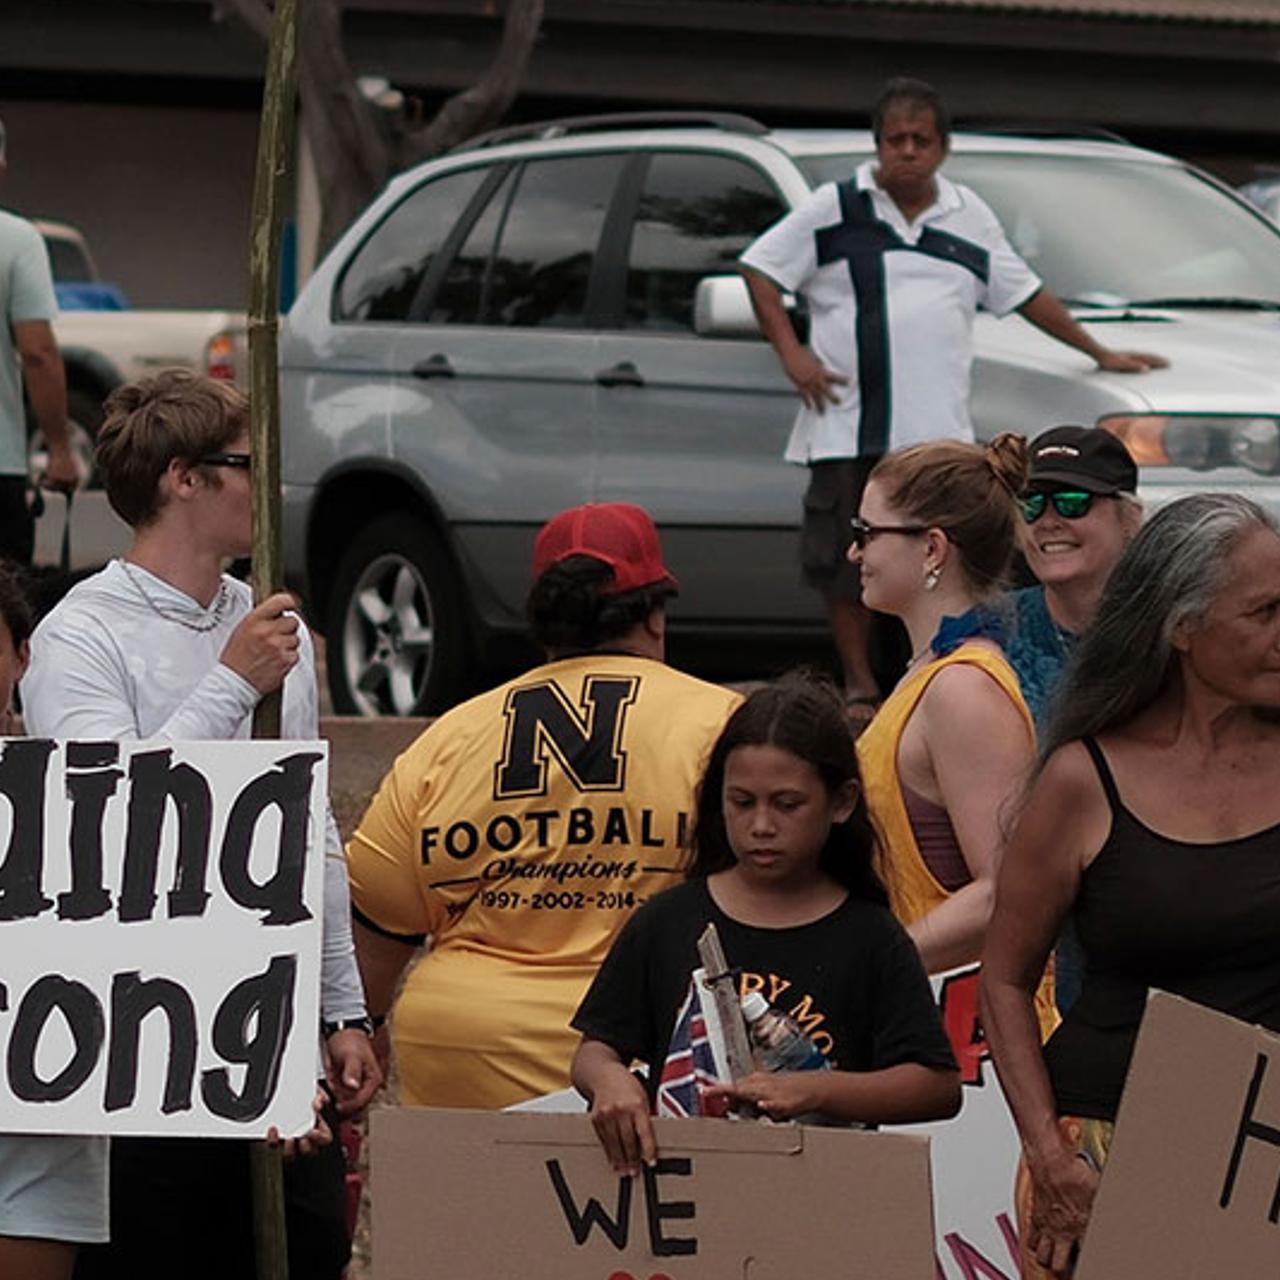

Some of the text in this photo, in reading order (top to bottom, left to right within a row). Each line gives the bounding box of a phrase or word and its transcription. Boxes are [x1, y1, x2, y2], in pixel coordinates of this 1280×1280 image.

[492, 673, 643, 802] N
[481, 854, 638, 885] Champions
[545, 1157, 698, 1258] WE
